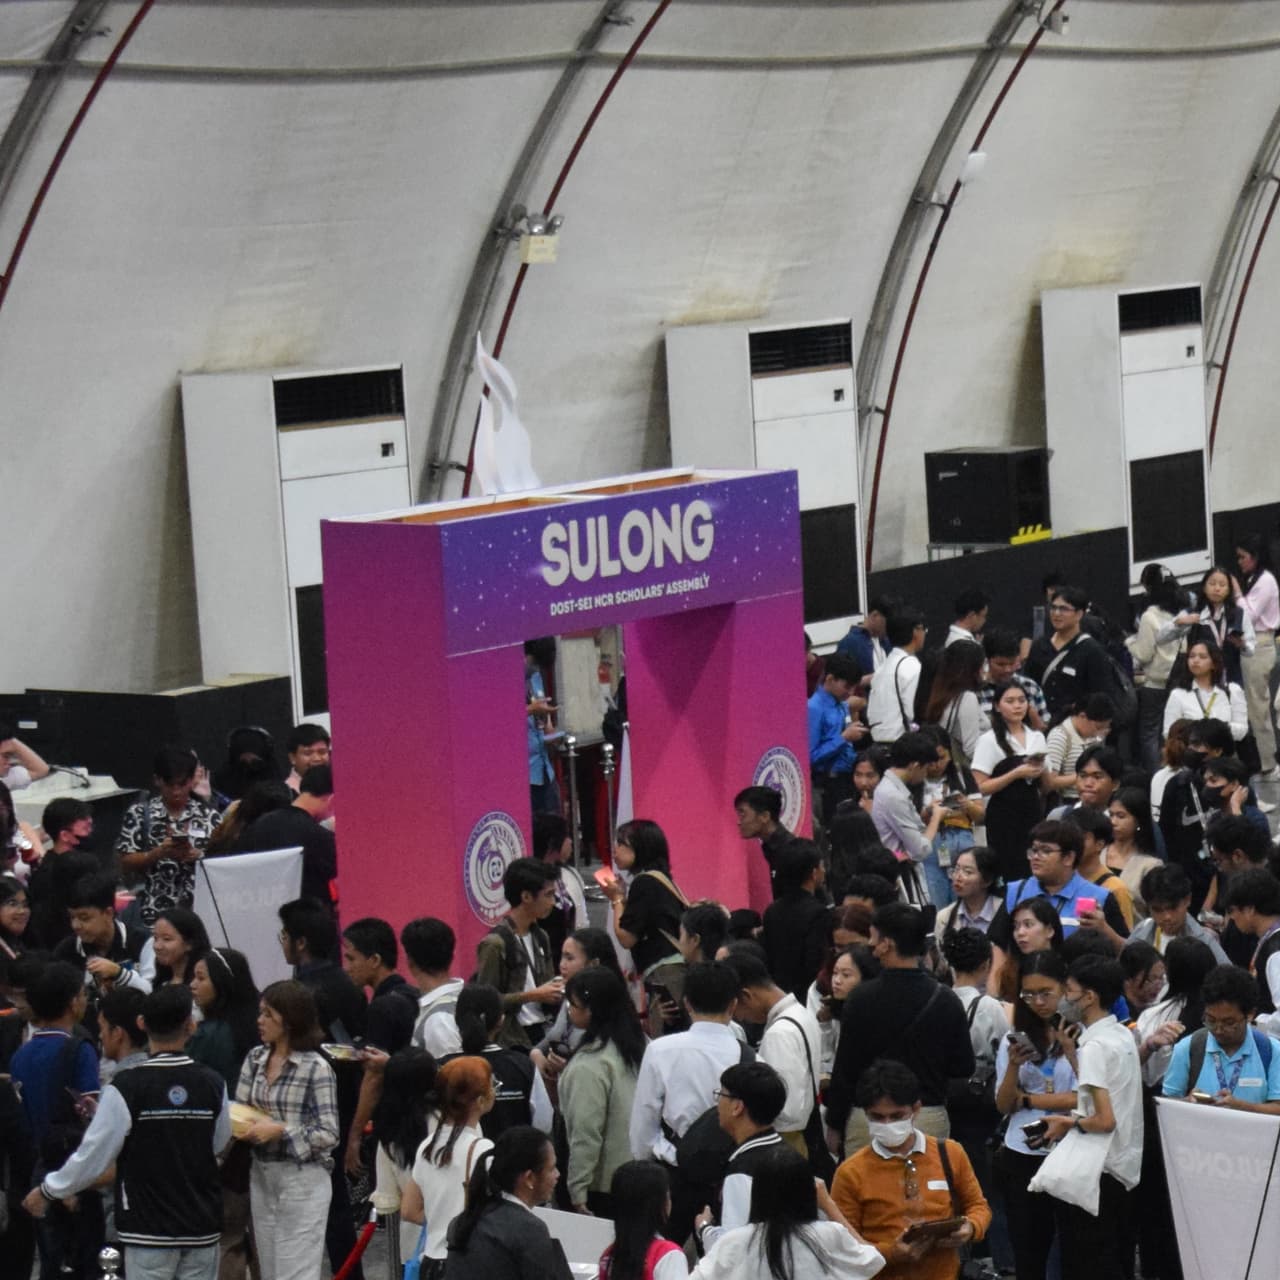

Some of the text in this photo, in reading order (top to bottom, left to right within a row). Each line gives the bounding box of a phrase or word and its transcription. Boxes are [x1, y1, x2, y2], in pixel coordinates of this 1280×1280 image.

[541, 500, 714, 586] SULONG
[551, 575, 710, 616] DOST-SEI NCR SCHOLARS' ASSEMBLY
